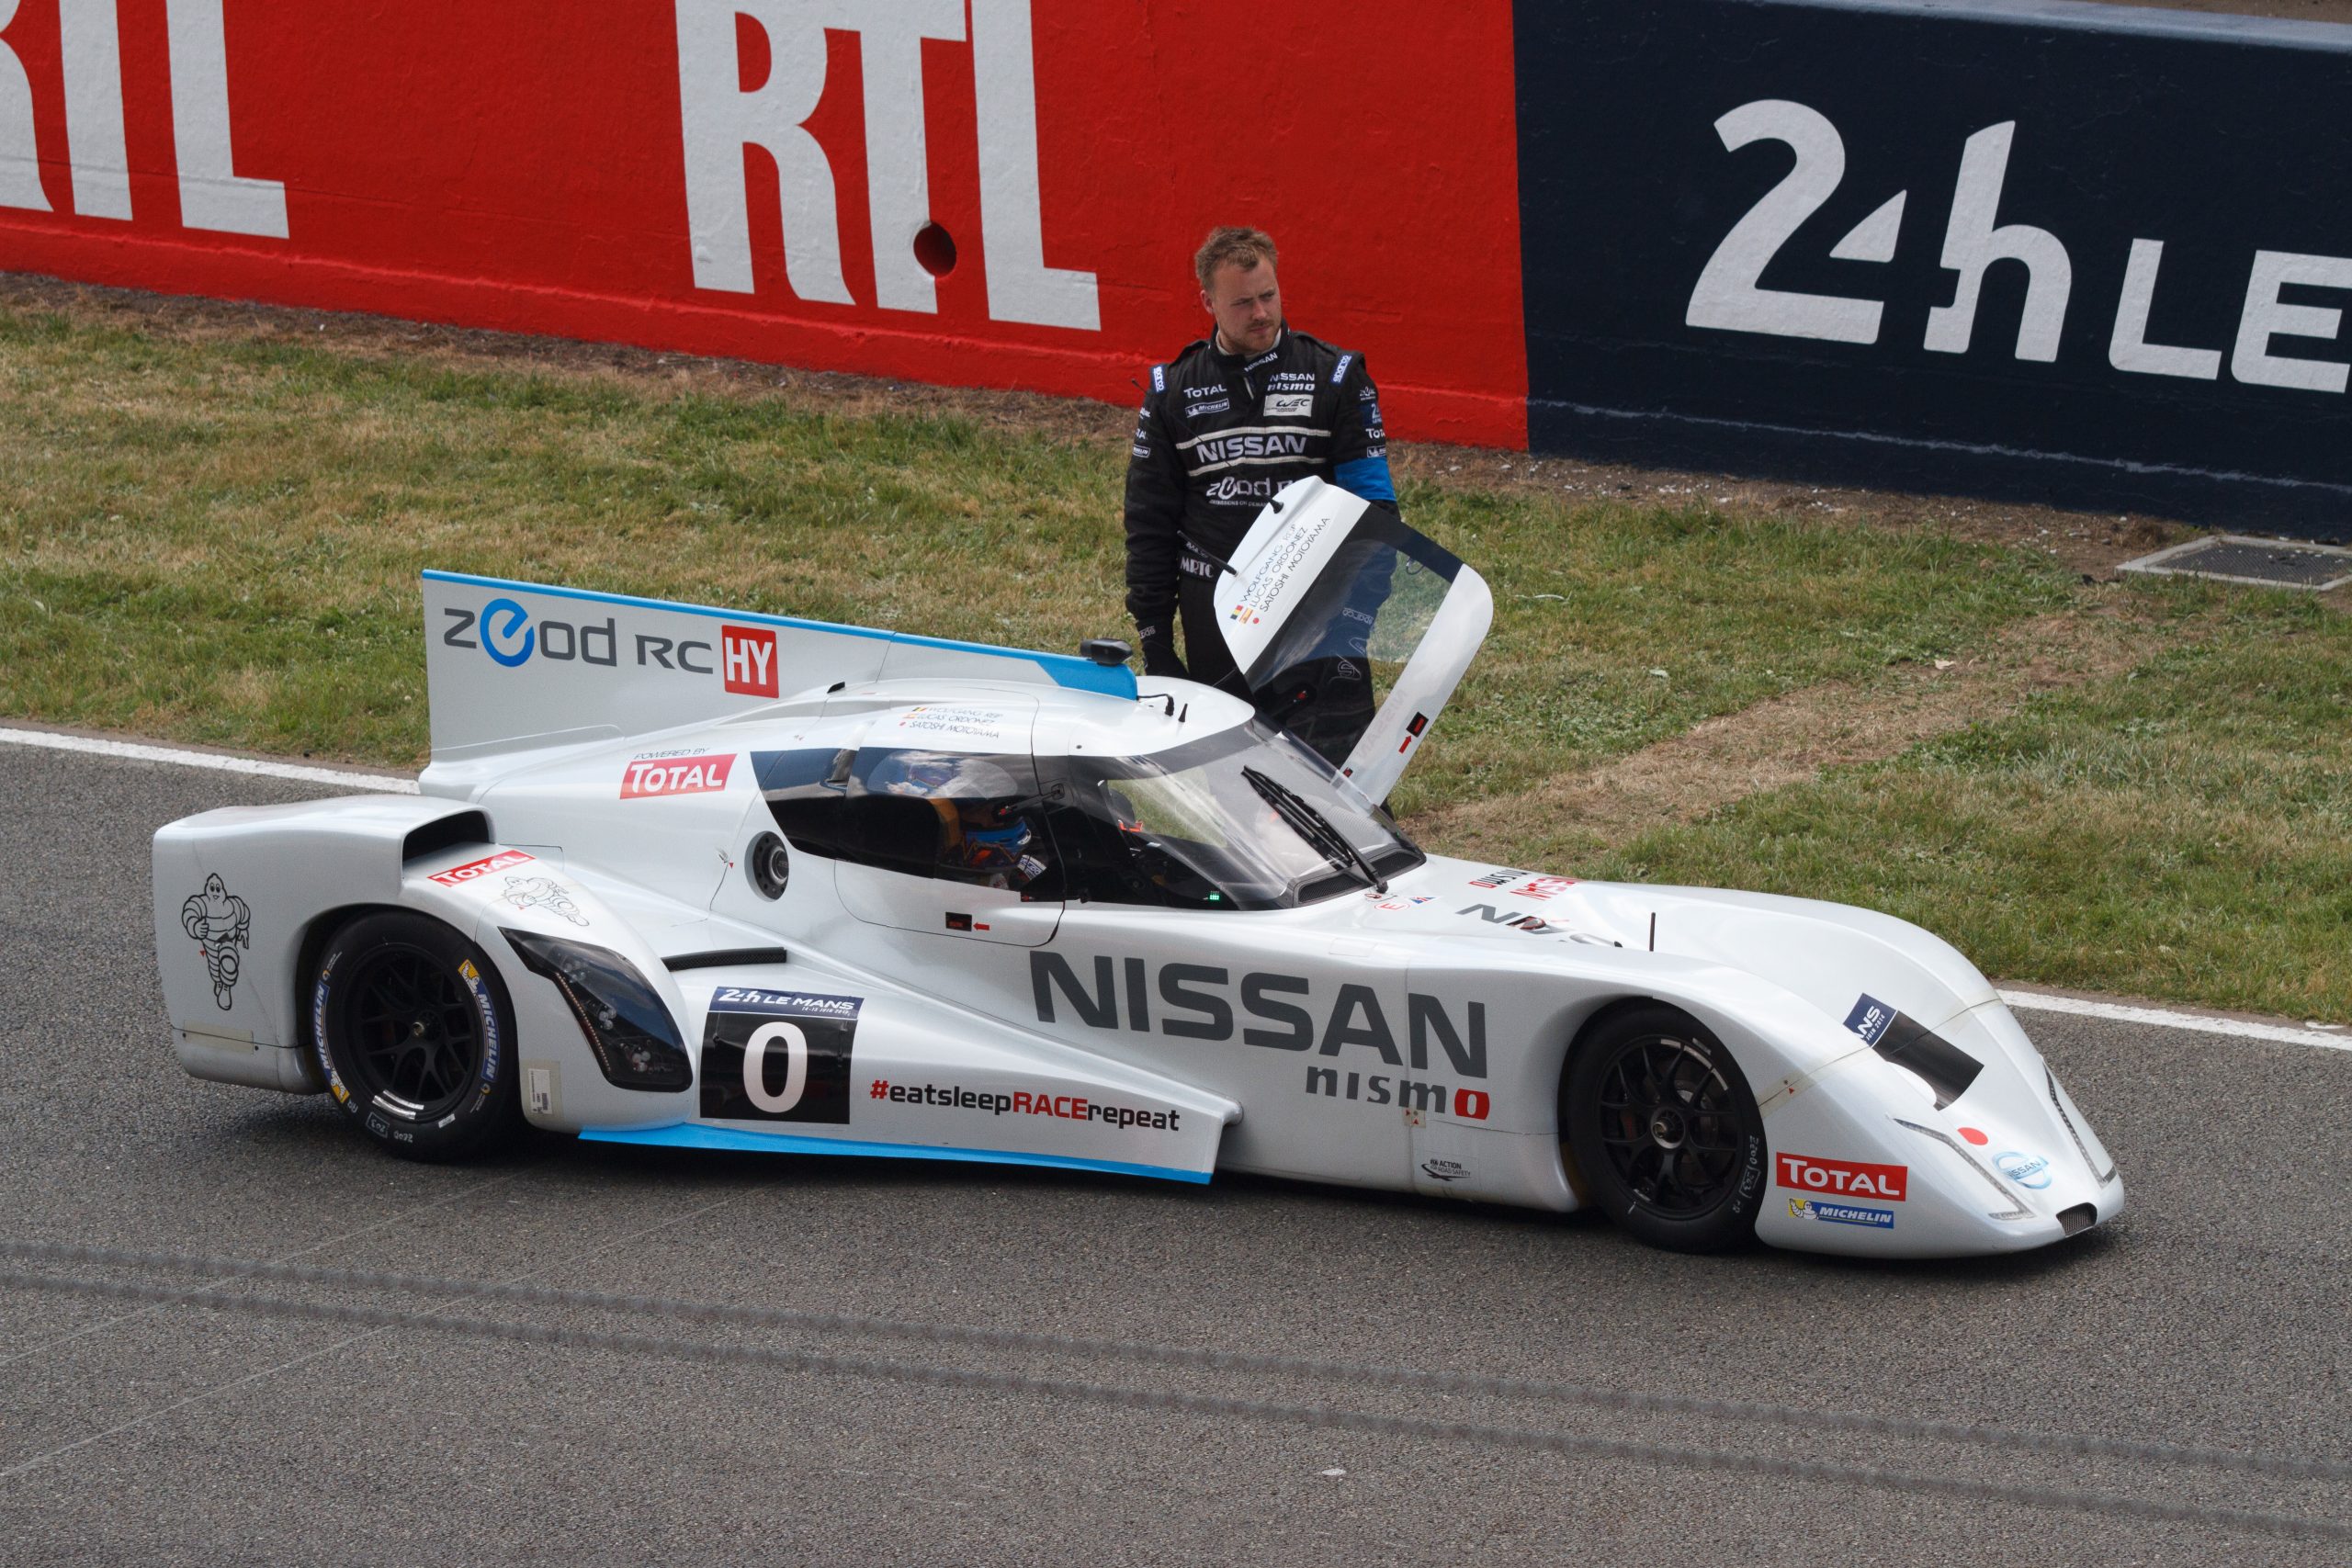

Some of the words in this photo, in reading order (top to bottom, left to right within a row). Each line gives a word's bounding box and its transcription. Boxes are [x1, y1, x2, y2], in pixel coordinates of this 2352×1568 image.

[675, 0, 1102, 332] RTL
[1686, 98, 2072, 363] 24h
[2109, 237, 2352, 393] LE
[1244, 352, 1278, 372] NISSAN
[1183, 384, 1227, 399] TOTAL
[1196, 434, 1307, 463] NISSAN
[1260, 573, 1290, 612] SATOSHI
[1288, 517, 1330, 572] MOTOYAMA
[1250, 577, 1273, 607] LUCAS
[725, 637, 774, 686] HY
[630, 762, 724, 794] TOTAL
[432, 855, 530, 883] TOTAL
[763, 996, 792, 1005] LE
[792, 998, 854, 1010] MANS
[1029, 950, 1487, 1078] NISSAN
[314, 984, 331, 1071] MICHELIN
[478, 993, 497, 1079] MICHELIN
[742, 1021, 808, 1113] 0
[870, 1079, 1180, 1132] #eatsleepRACErepeat
[1306, 1066, 1490, 1120] nismo
[1439, 1160, 1462, 1169] ACTION
[1781, 1157, 1900, 1196] TOTAL
[1819, 1206, 1893, 1224] MICHELIN
